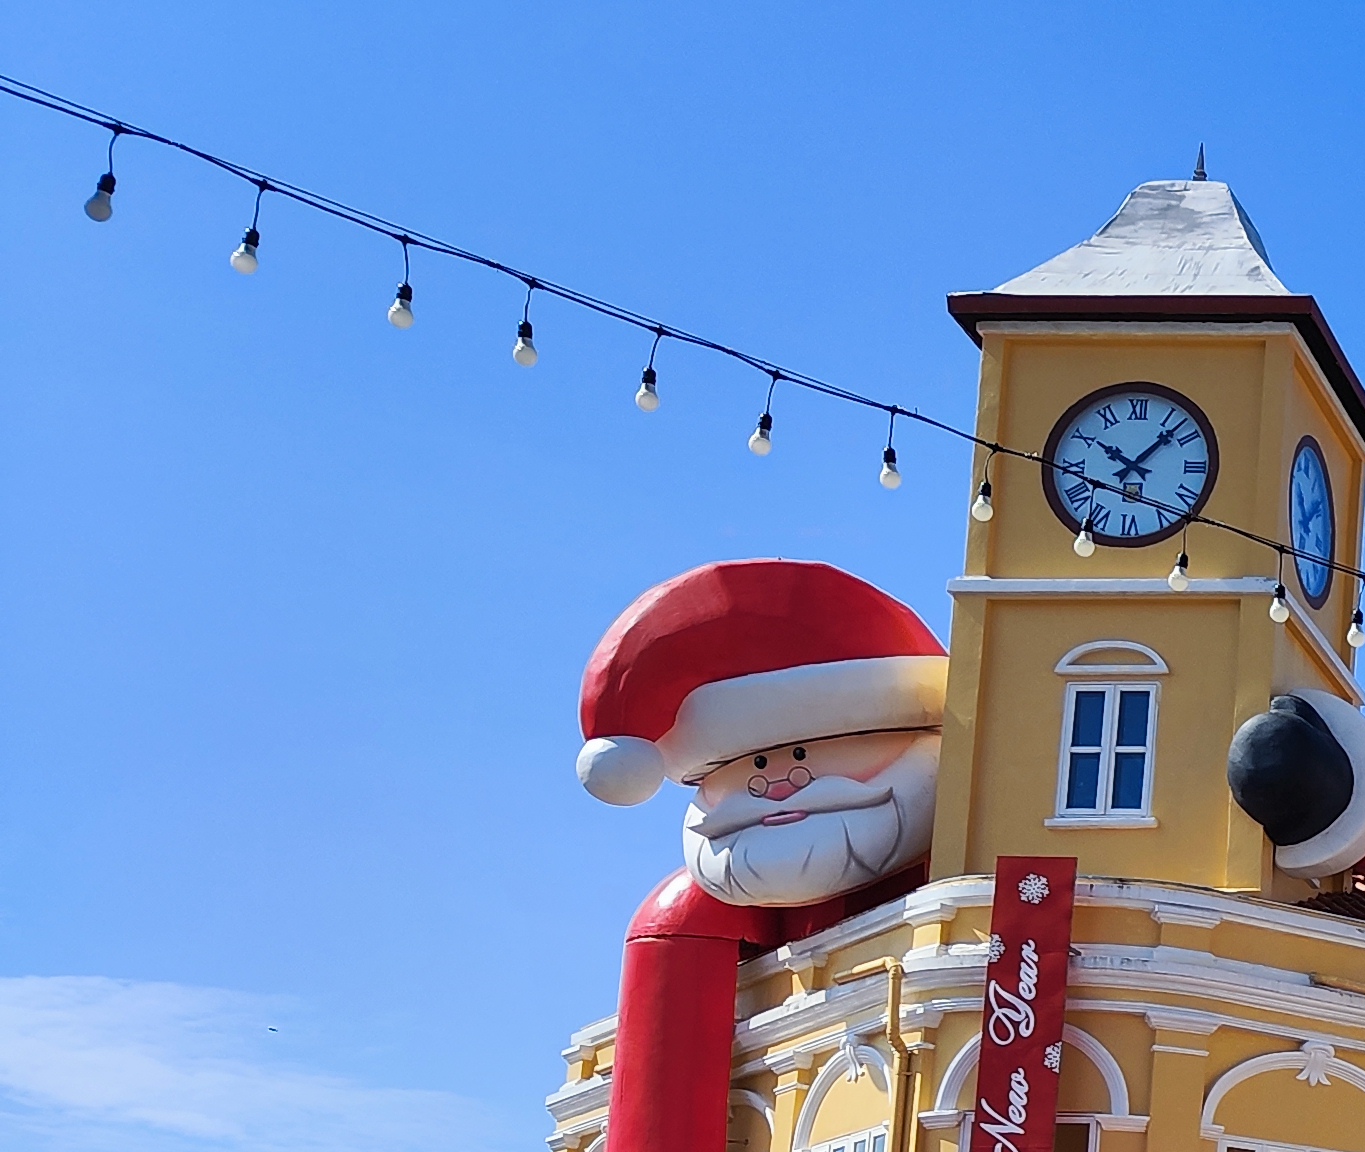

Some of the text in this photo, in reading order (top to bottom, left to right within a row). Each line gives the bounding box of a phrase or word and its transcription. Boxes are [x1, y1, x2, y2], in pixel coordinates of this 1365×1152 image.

[1095, 404, 1120, 430] XI
[1127, 399, 1149, 420] XII
[1071, 428, 1096, 448] X
[1177, 429, 1201, 447] II
[1184, 460, 1206, 474] III
[1120, 514, 1139, 535] VI
[989, 939, 1039, 1046] Year
